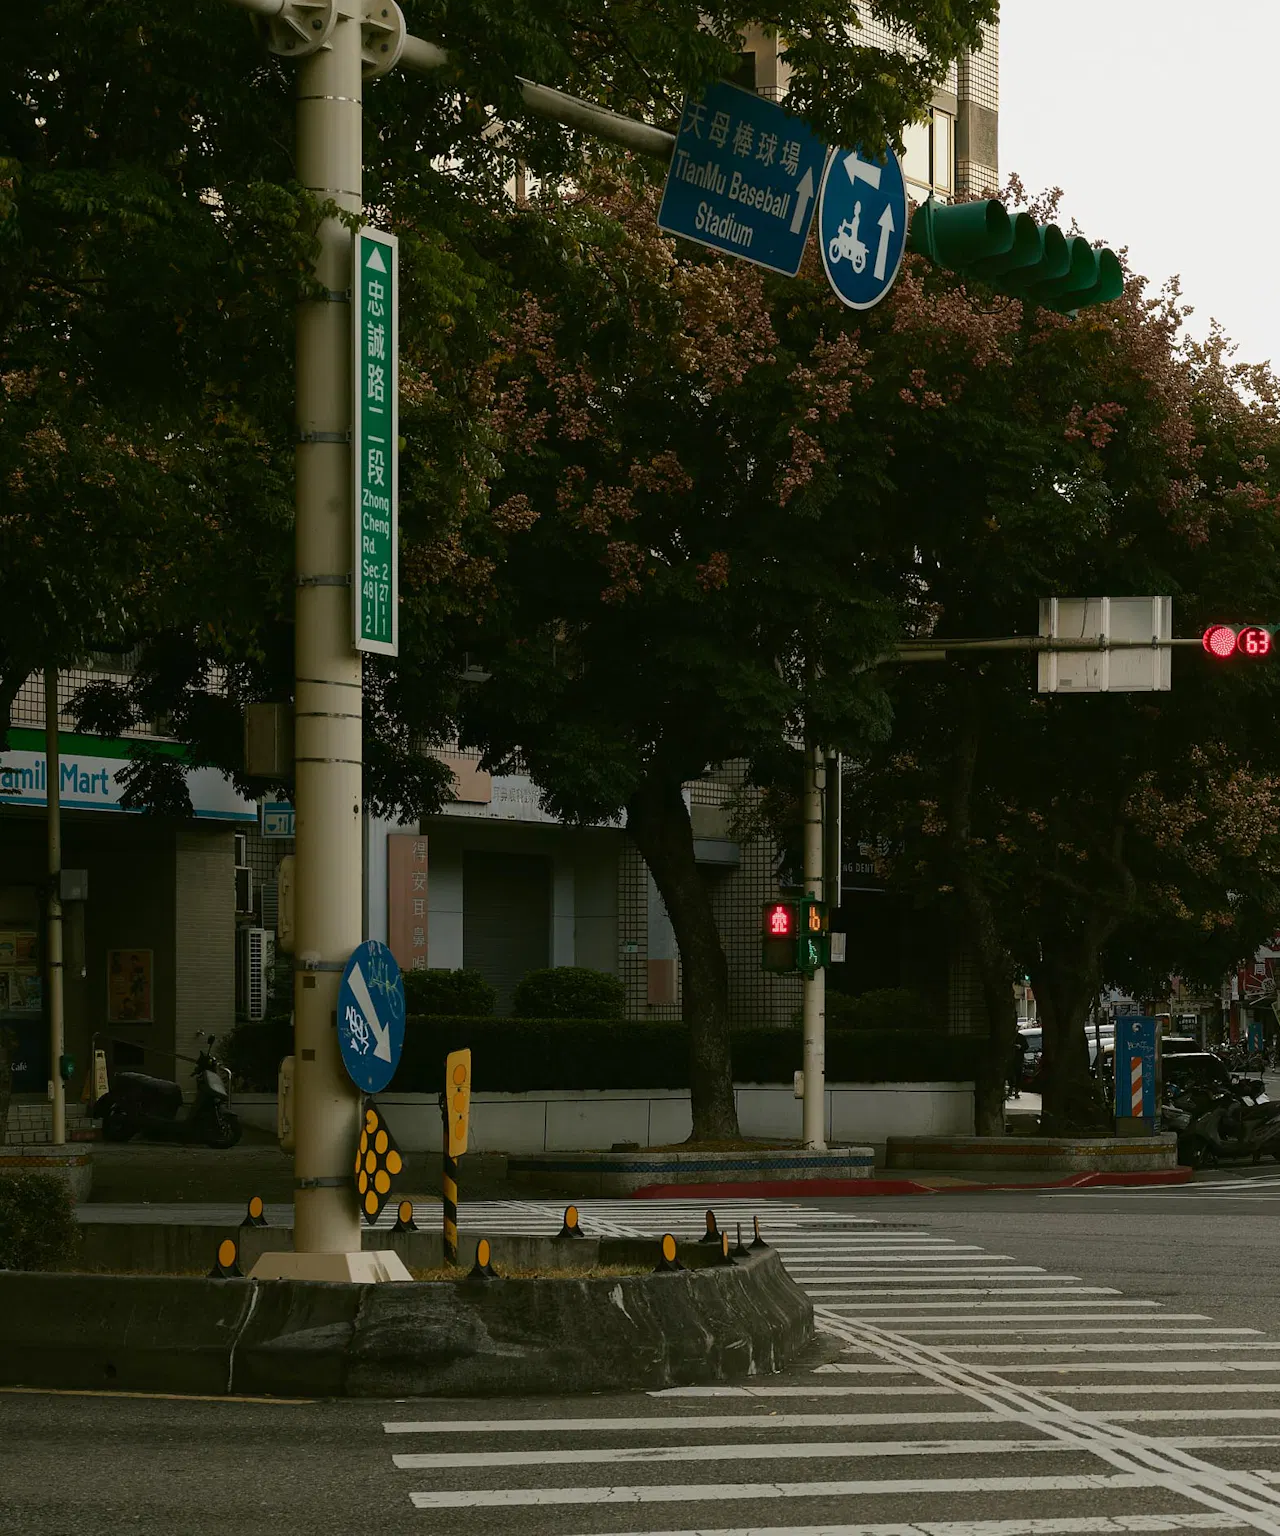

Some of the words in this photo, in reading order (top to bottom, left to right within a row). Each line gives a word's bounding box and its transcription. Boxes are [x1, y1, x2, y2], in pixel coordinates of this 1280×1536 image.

[682, 99, 802, 177] 天母棒球場
[675, 148, 727, 196] TianMu
[728, 170, 791, 220] Baseball
[694, 200, 754, 248] Stadium
[367, 279, 386, 488] 忠誠路二段
[362, 488, 390, 516] Zhong
[362, 512, 390, 540] Cheng
[362, 535, 377, 555] Rd.
[362, 559, 381, 579] Sec.
[382, 563, 389, 581] 2
[1246, 631, 1269, 654] 63
